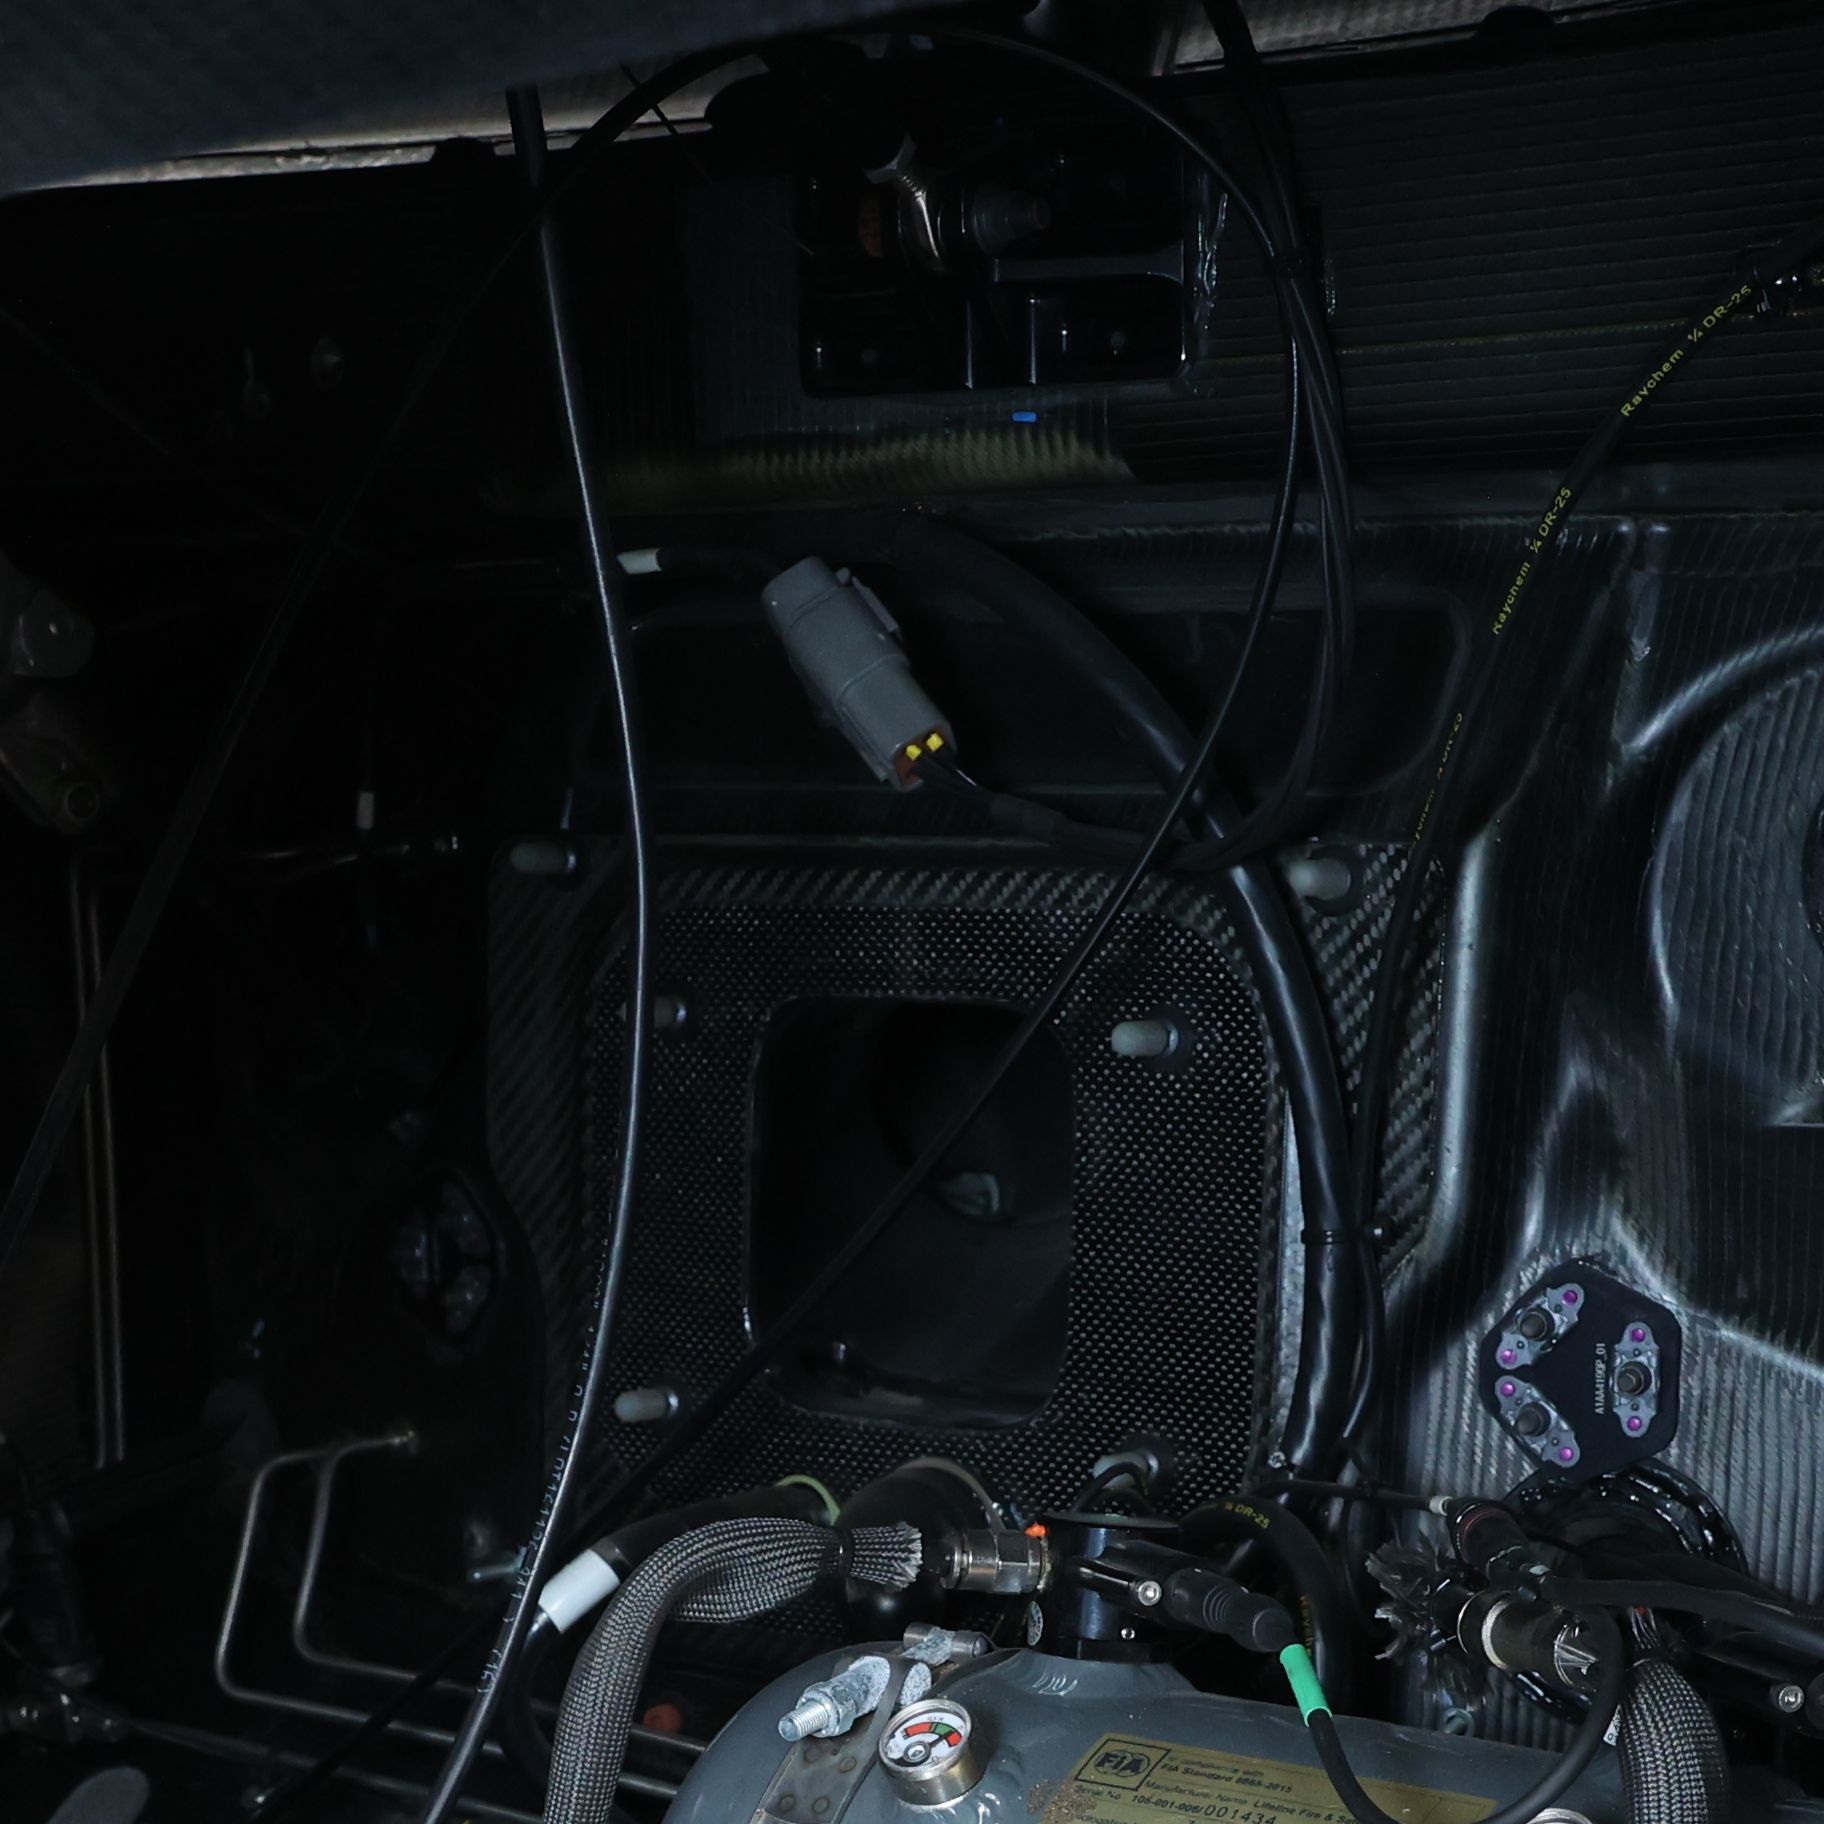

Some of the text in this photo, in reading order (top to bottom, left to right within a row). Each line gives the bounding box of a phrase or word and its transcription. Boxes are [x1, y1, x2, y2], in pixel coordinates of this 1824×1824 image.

[1096, 1752, 1144, 1773] FIA
[1182, 1766, 1233, 1782] Standard
[1298, 1808, 1321, 1820] Fire
[1324, 1813, 1333, 1822] &
